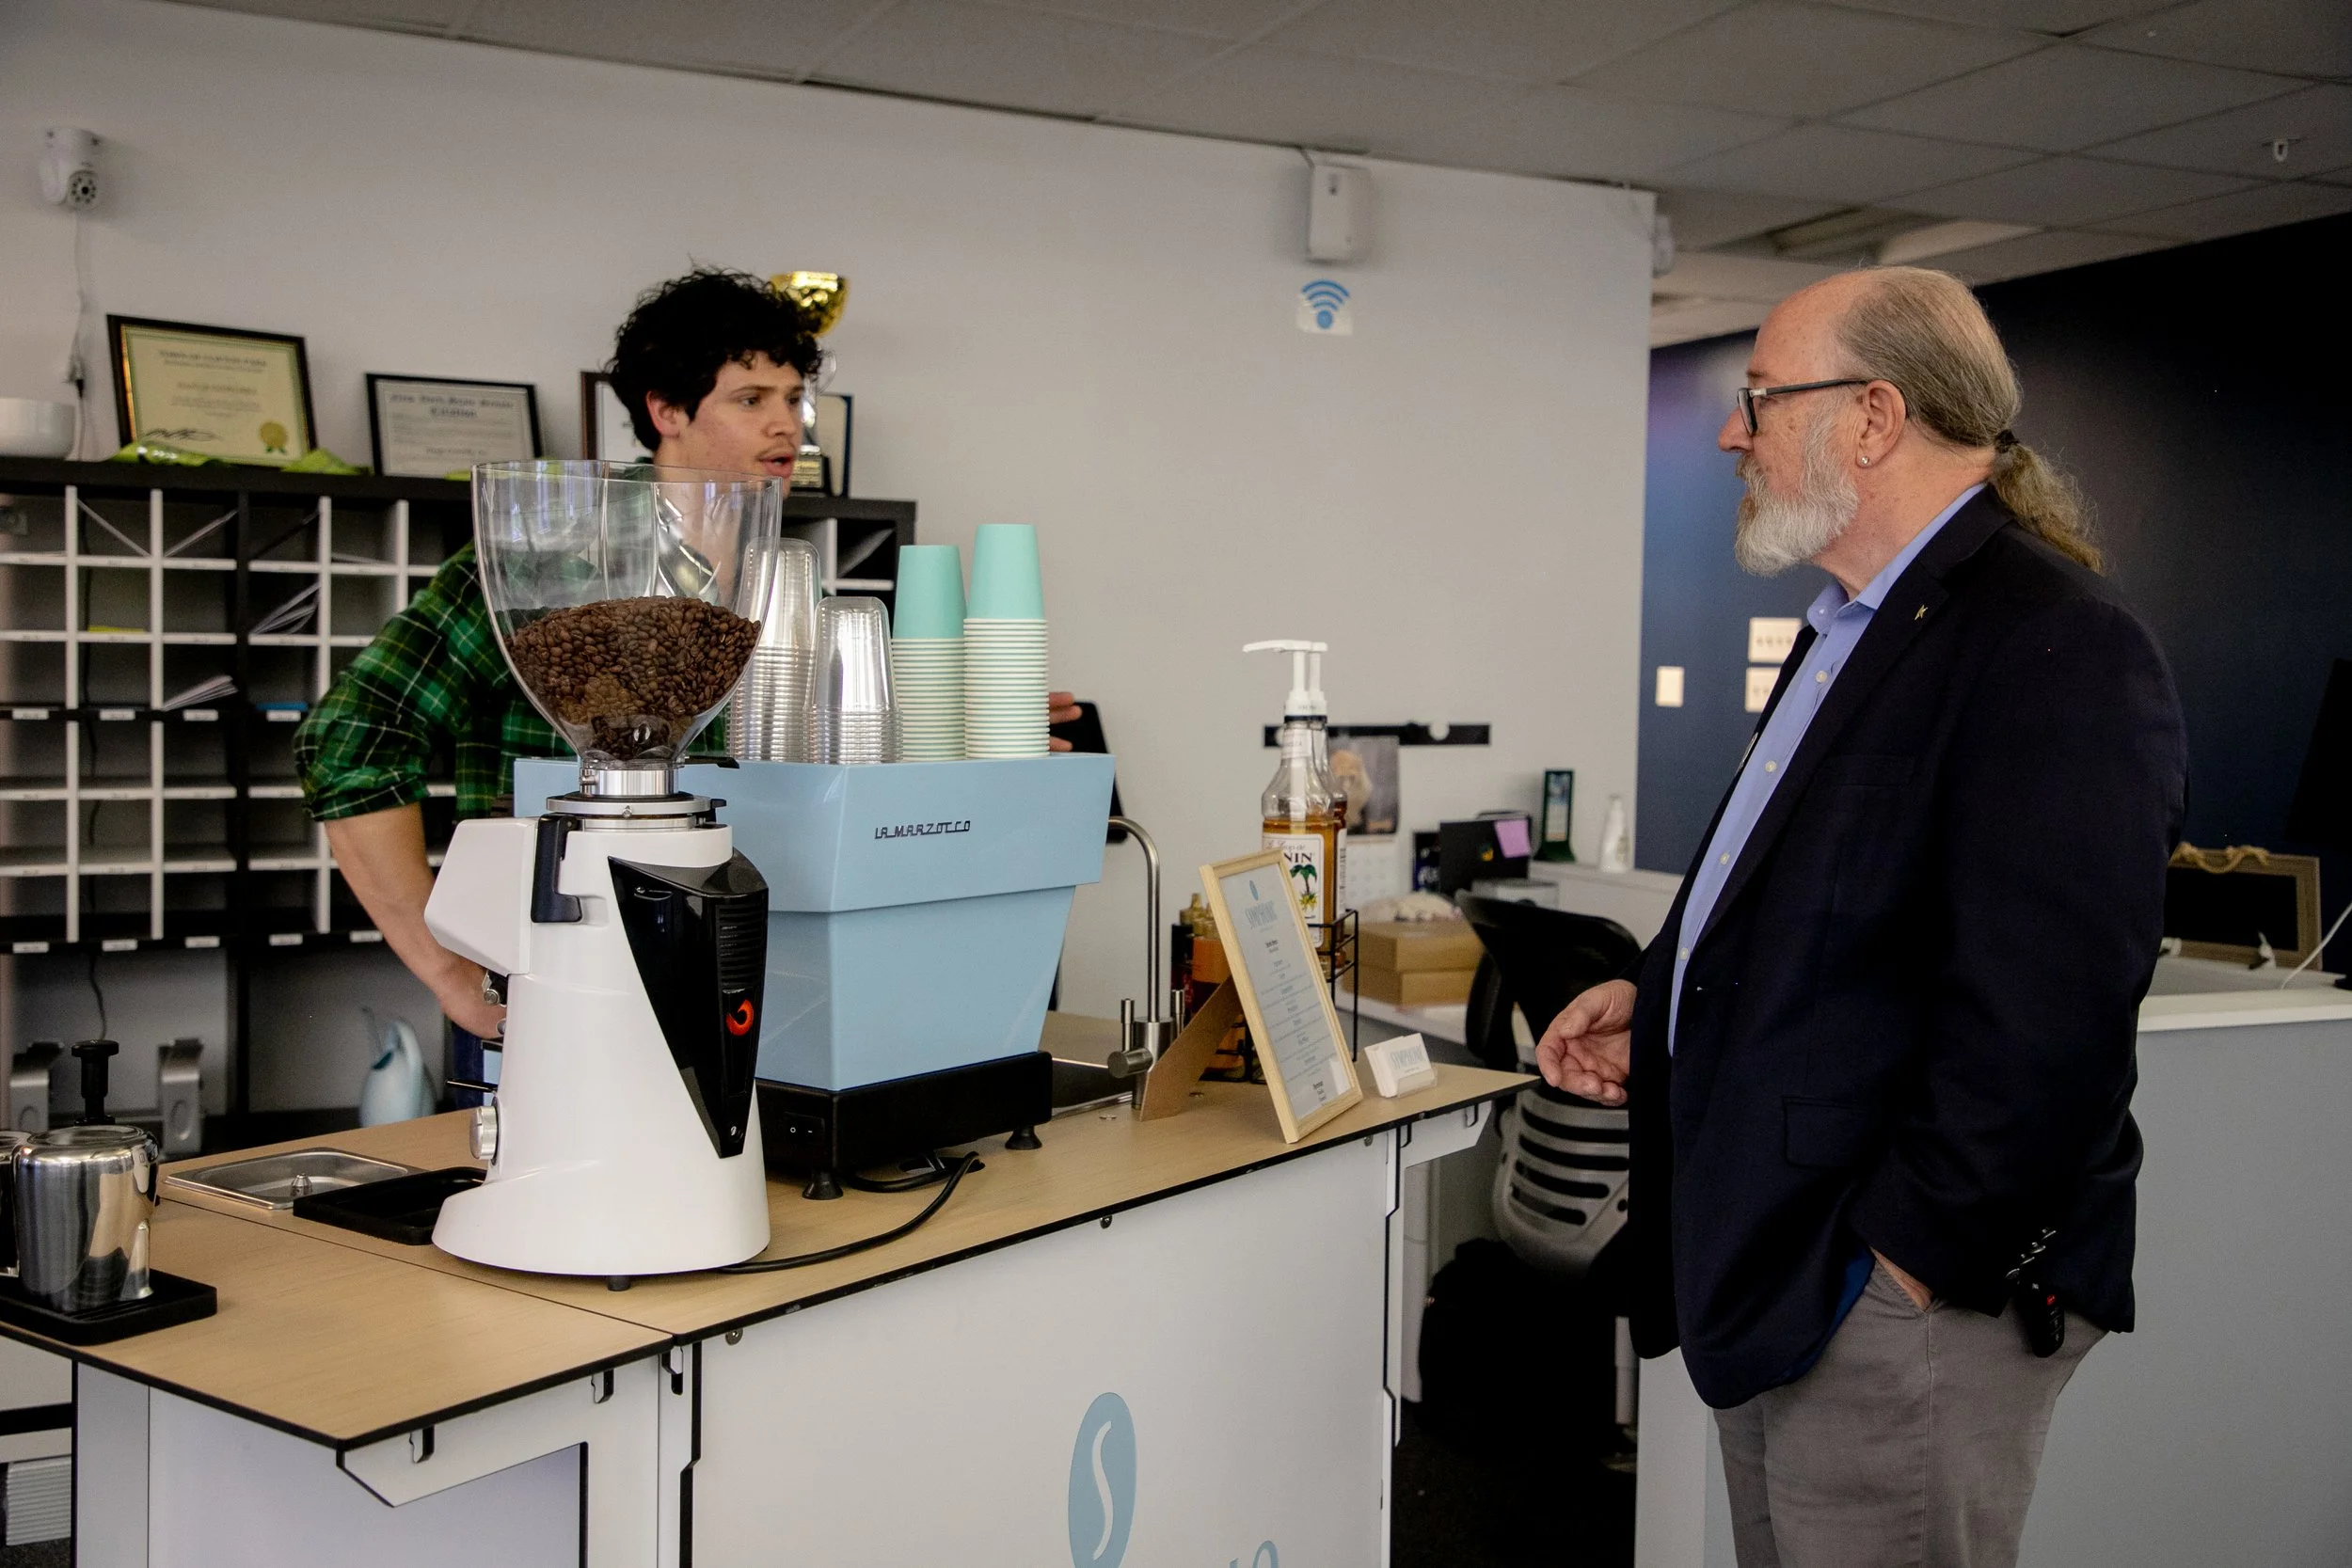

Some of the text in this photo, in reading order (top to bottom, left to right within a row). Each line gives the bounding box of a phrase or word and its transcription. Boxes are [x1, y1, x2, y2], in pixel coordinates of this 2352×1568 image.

[875, 820, 971, 839] LA MARZOCCO
[1283, 852, 1312, 863] NIN
